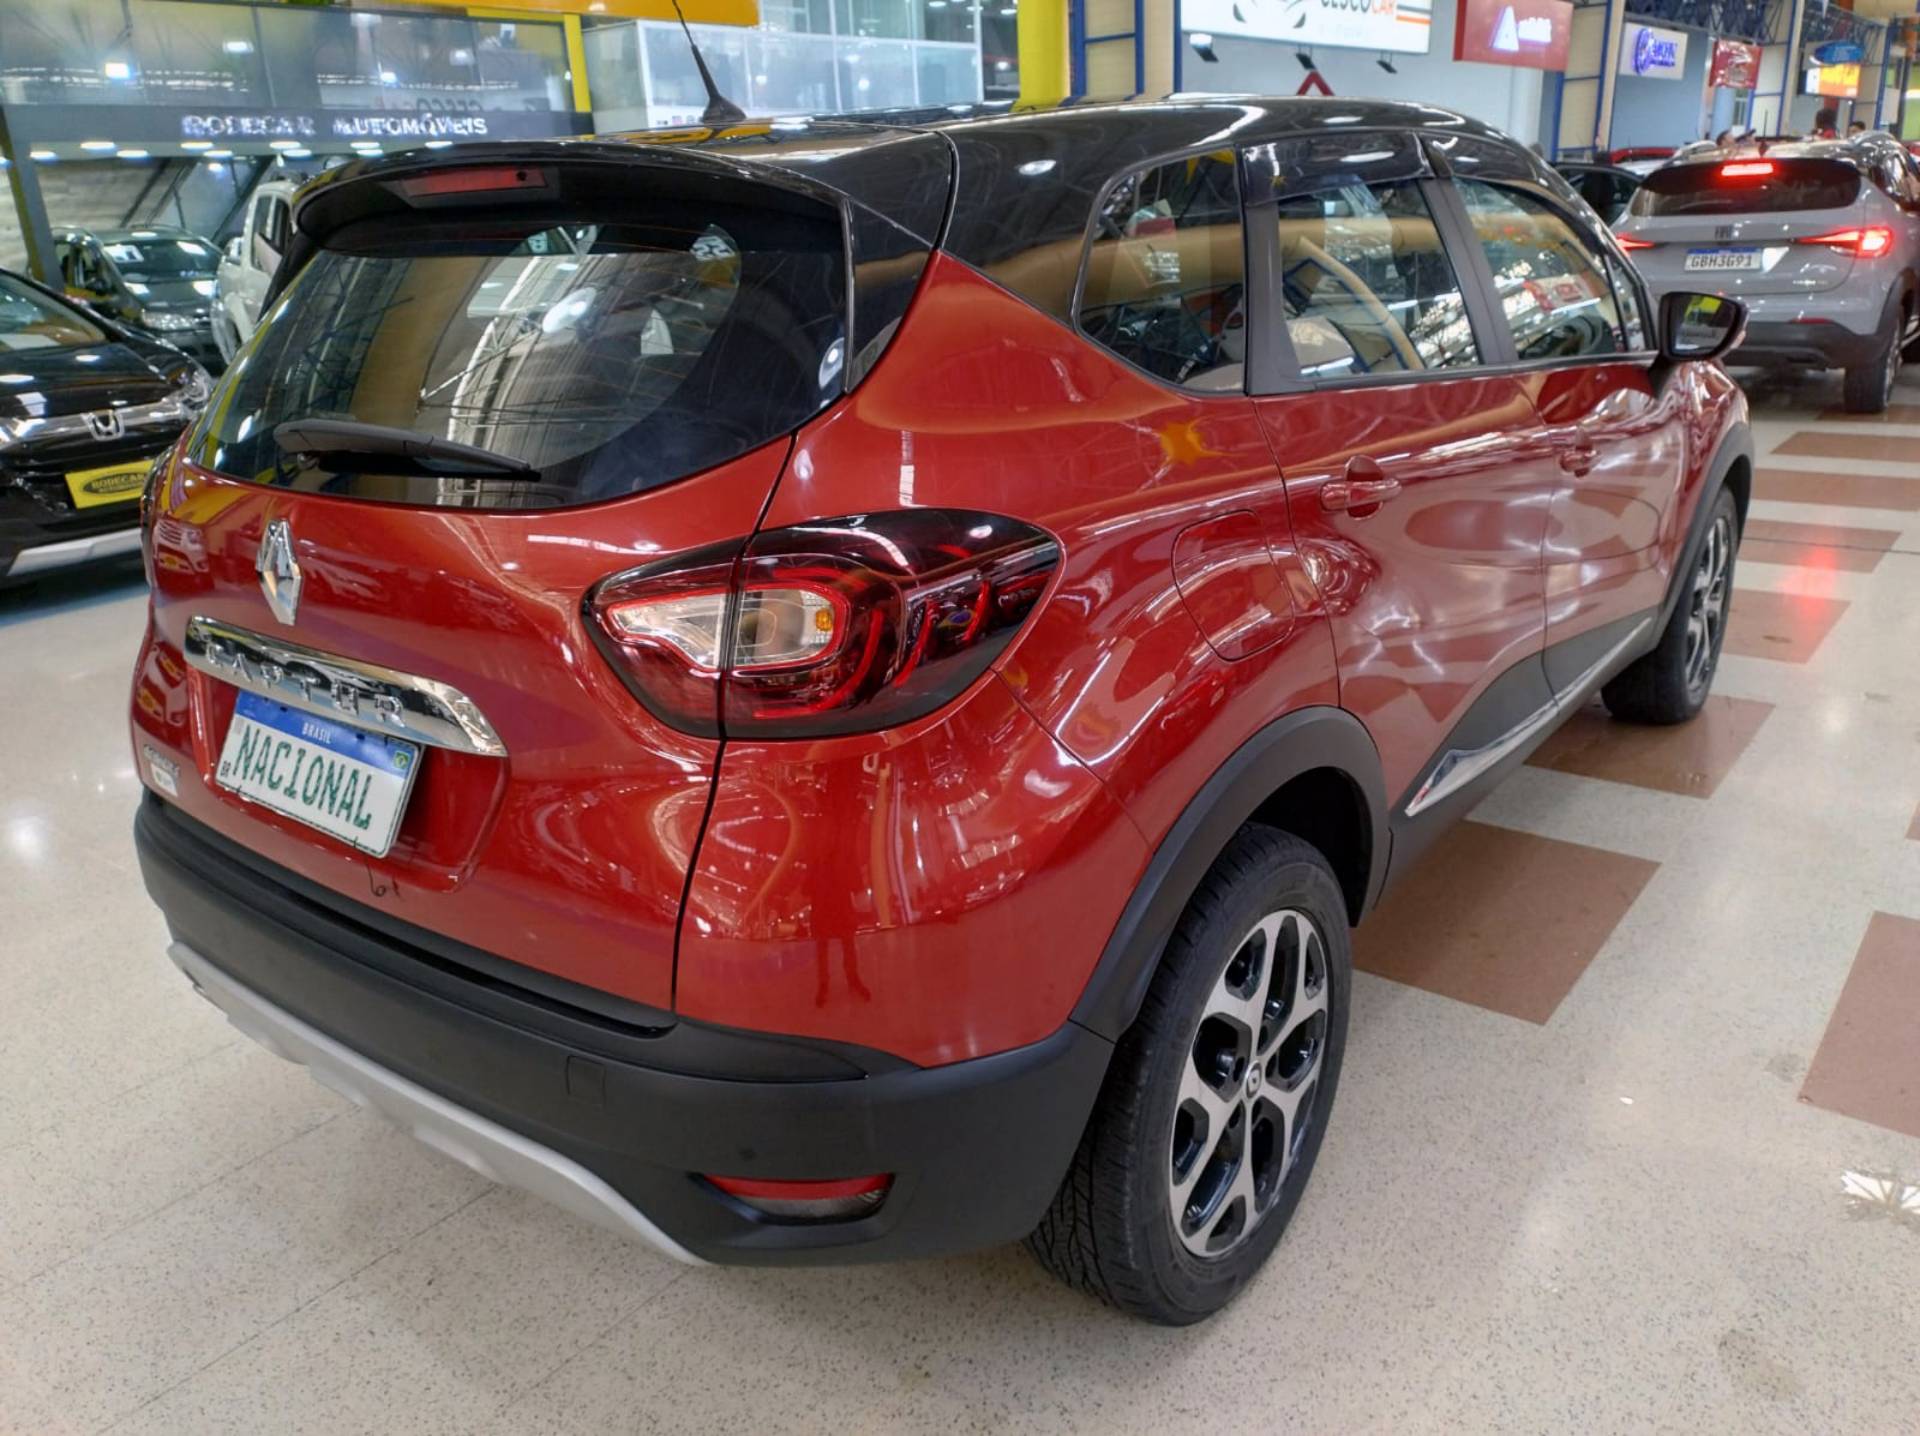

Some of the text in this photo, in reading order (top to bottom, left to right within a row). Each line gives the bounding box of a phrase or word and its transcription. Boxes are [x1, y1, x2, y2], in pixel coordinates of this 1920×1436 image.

[332, 112, 488, 136] AUTOMÓVEIS
[1690, 255, 1753, 268] GBH3G91
[206, 643, 406, 728] CAPTUR
[302, 722, 331, 745] BRASIL
[232, 724, 372, 831] NACIONAL
